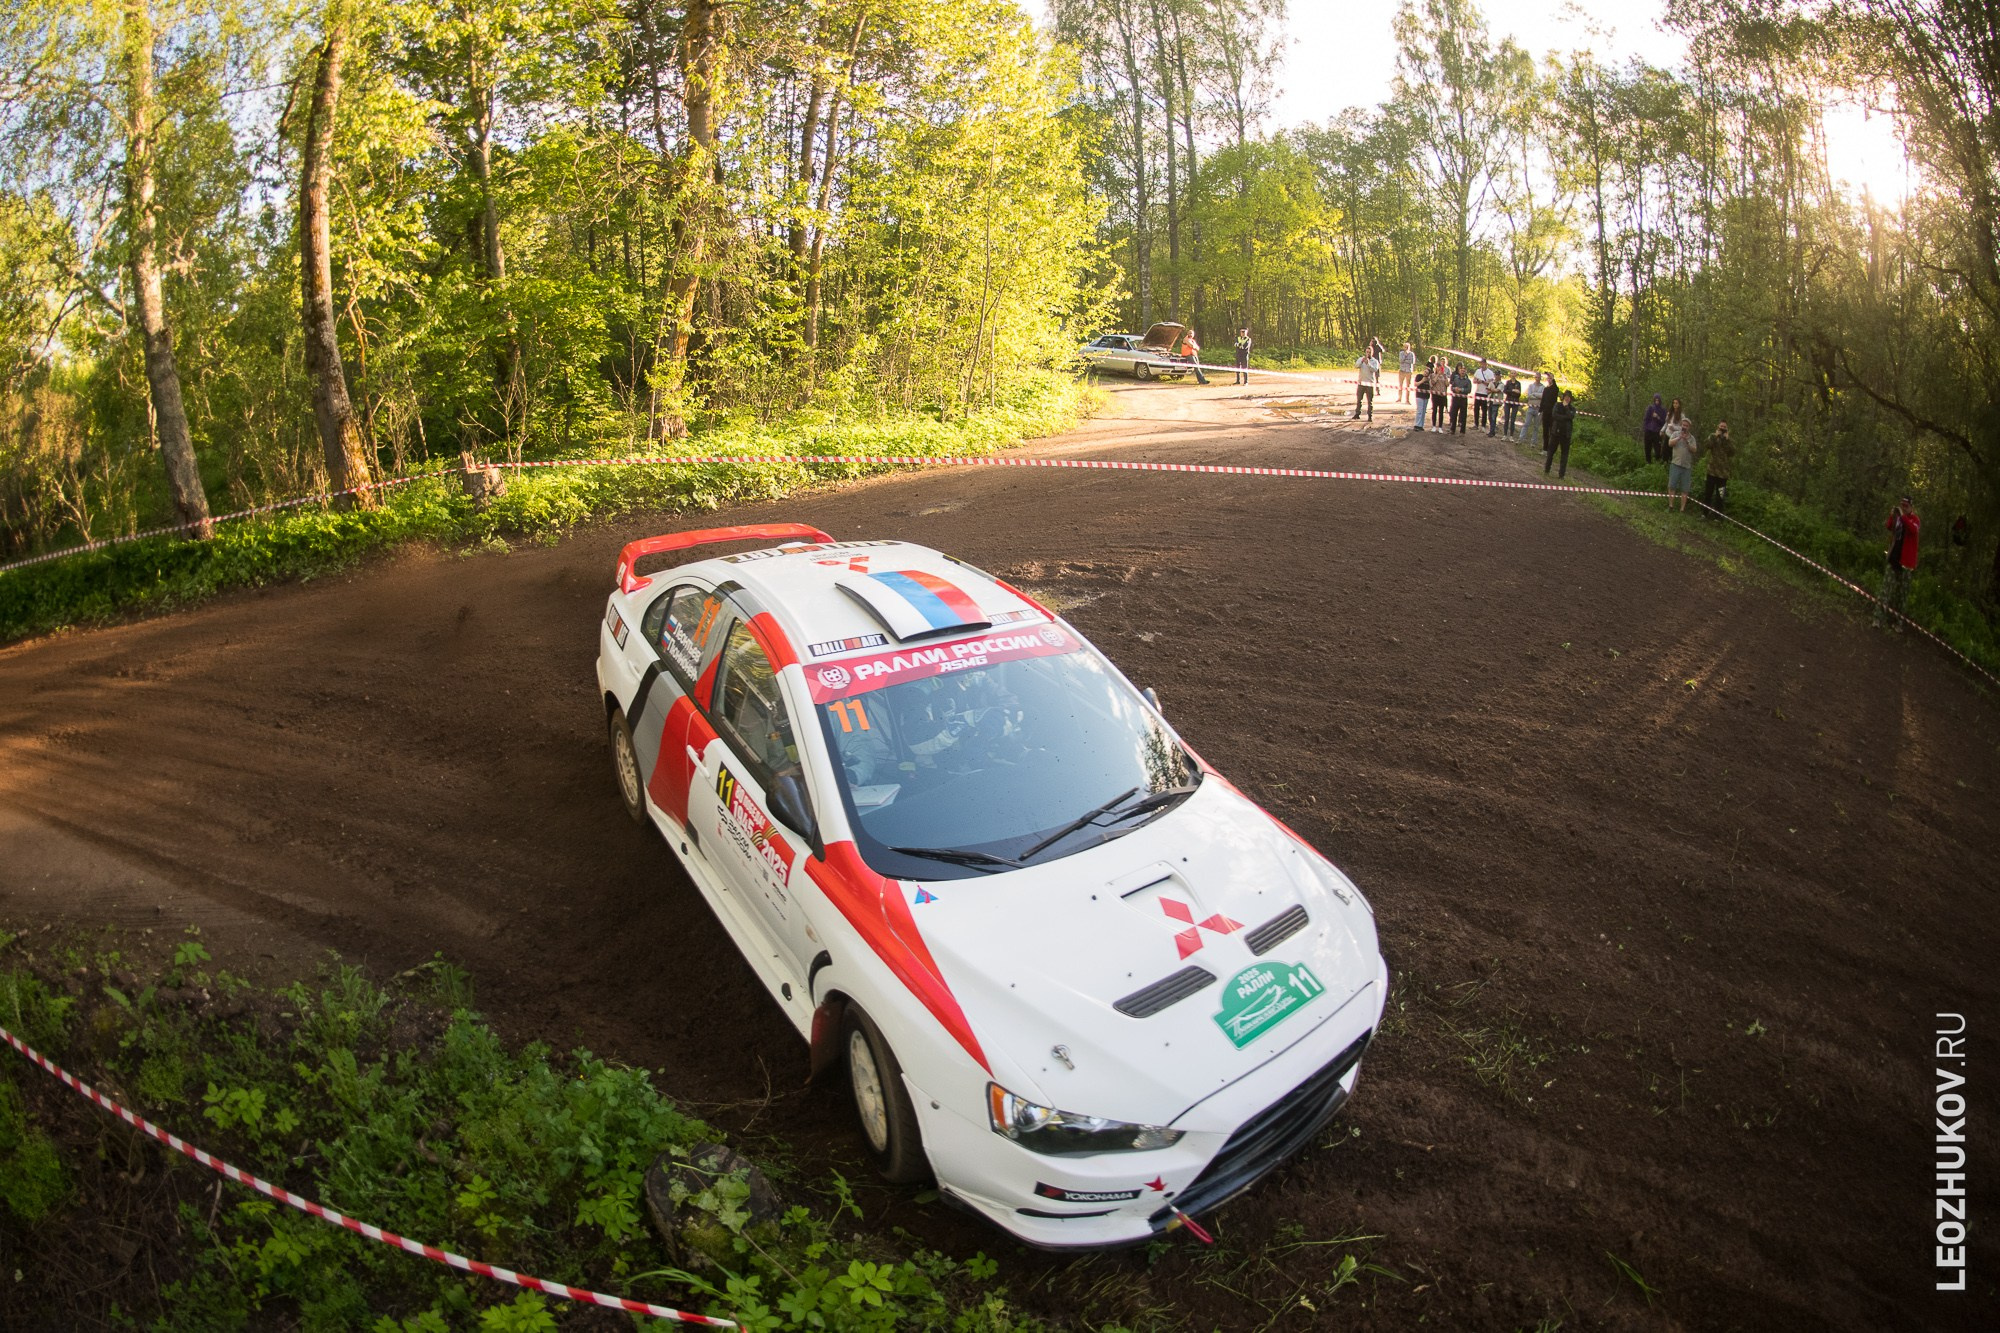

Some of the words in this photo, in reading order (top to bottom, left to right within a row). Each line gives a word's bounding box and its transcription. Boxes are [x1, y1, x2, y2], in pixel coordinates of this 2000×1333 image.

[694, 596, 721, 647] 11
[854, 644, 949, 681] РАЛЛИ
[950, 634, 1042, 659] РОССИИ
[828, 699, 871, 733] 11
[718, 768, 735, 809] 11
[732, 801, 754, 839] 1945
[761, 839, 789, 886] 2025
[1236, 970, 1276, 999] РАЛЛИ
[1237, 967, 1260, 985] 2025
[1288, 966, 1321, 998] 11
[1064, 1190, 1134, 1201] YOKOHAMA
